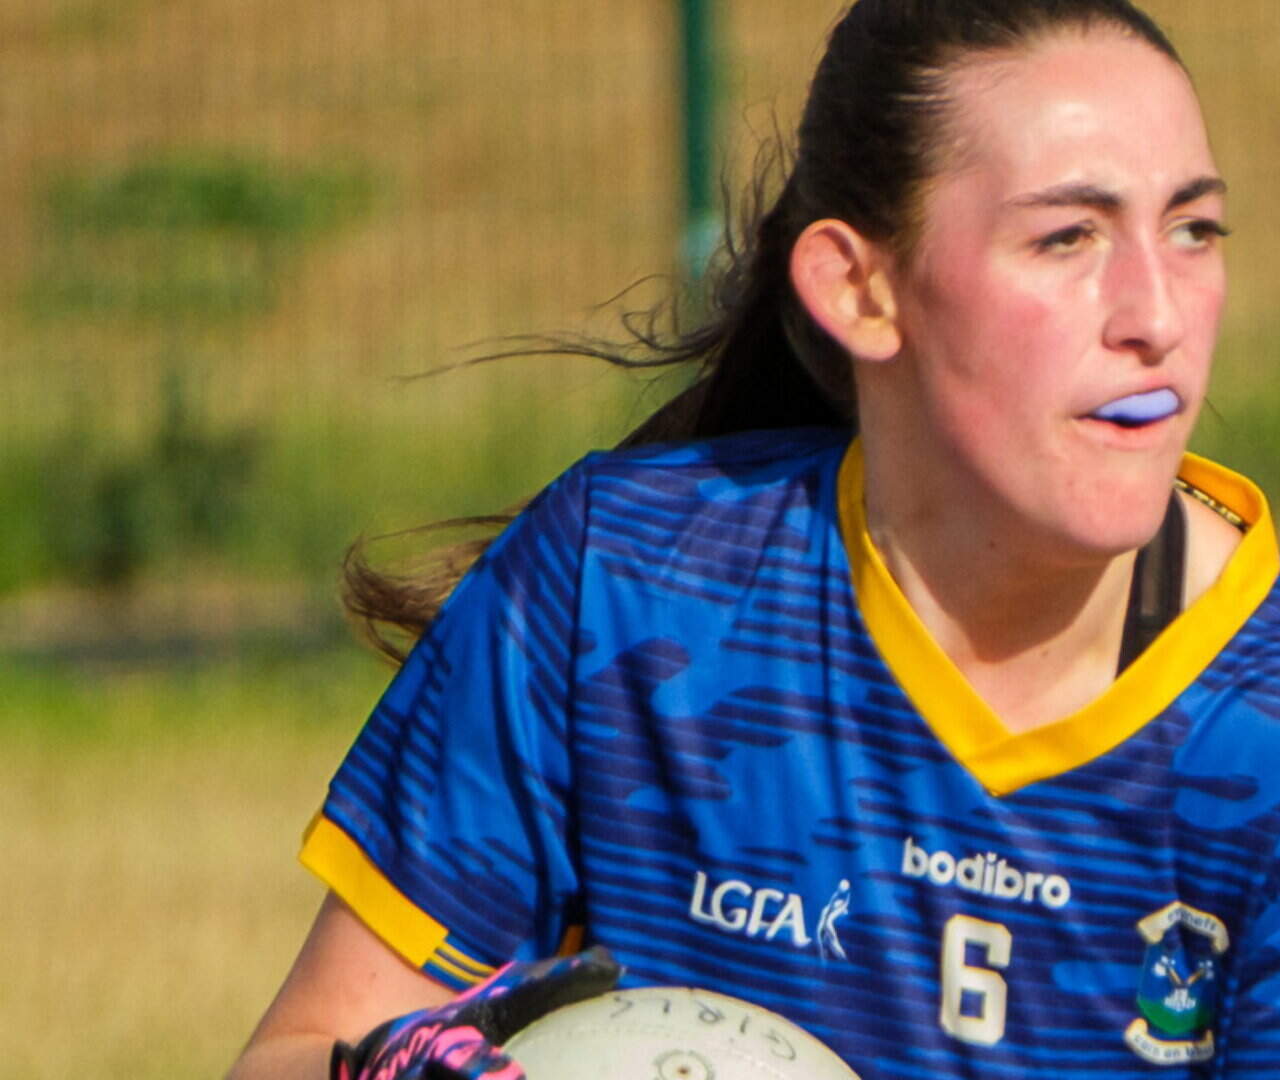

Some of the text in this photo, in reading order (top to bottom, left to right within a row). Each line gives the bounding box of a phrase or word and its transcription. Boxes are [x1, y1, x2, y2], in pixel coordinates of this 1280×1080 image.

[690, 870, 811, 947] LGFA
[902, 837, 1071, 908] bodibro
[940, 913, 1012, 1045] 6
